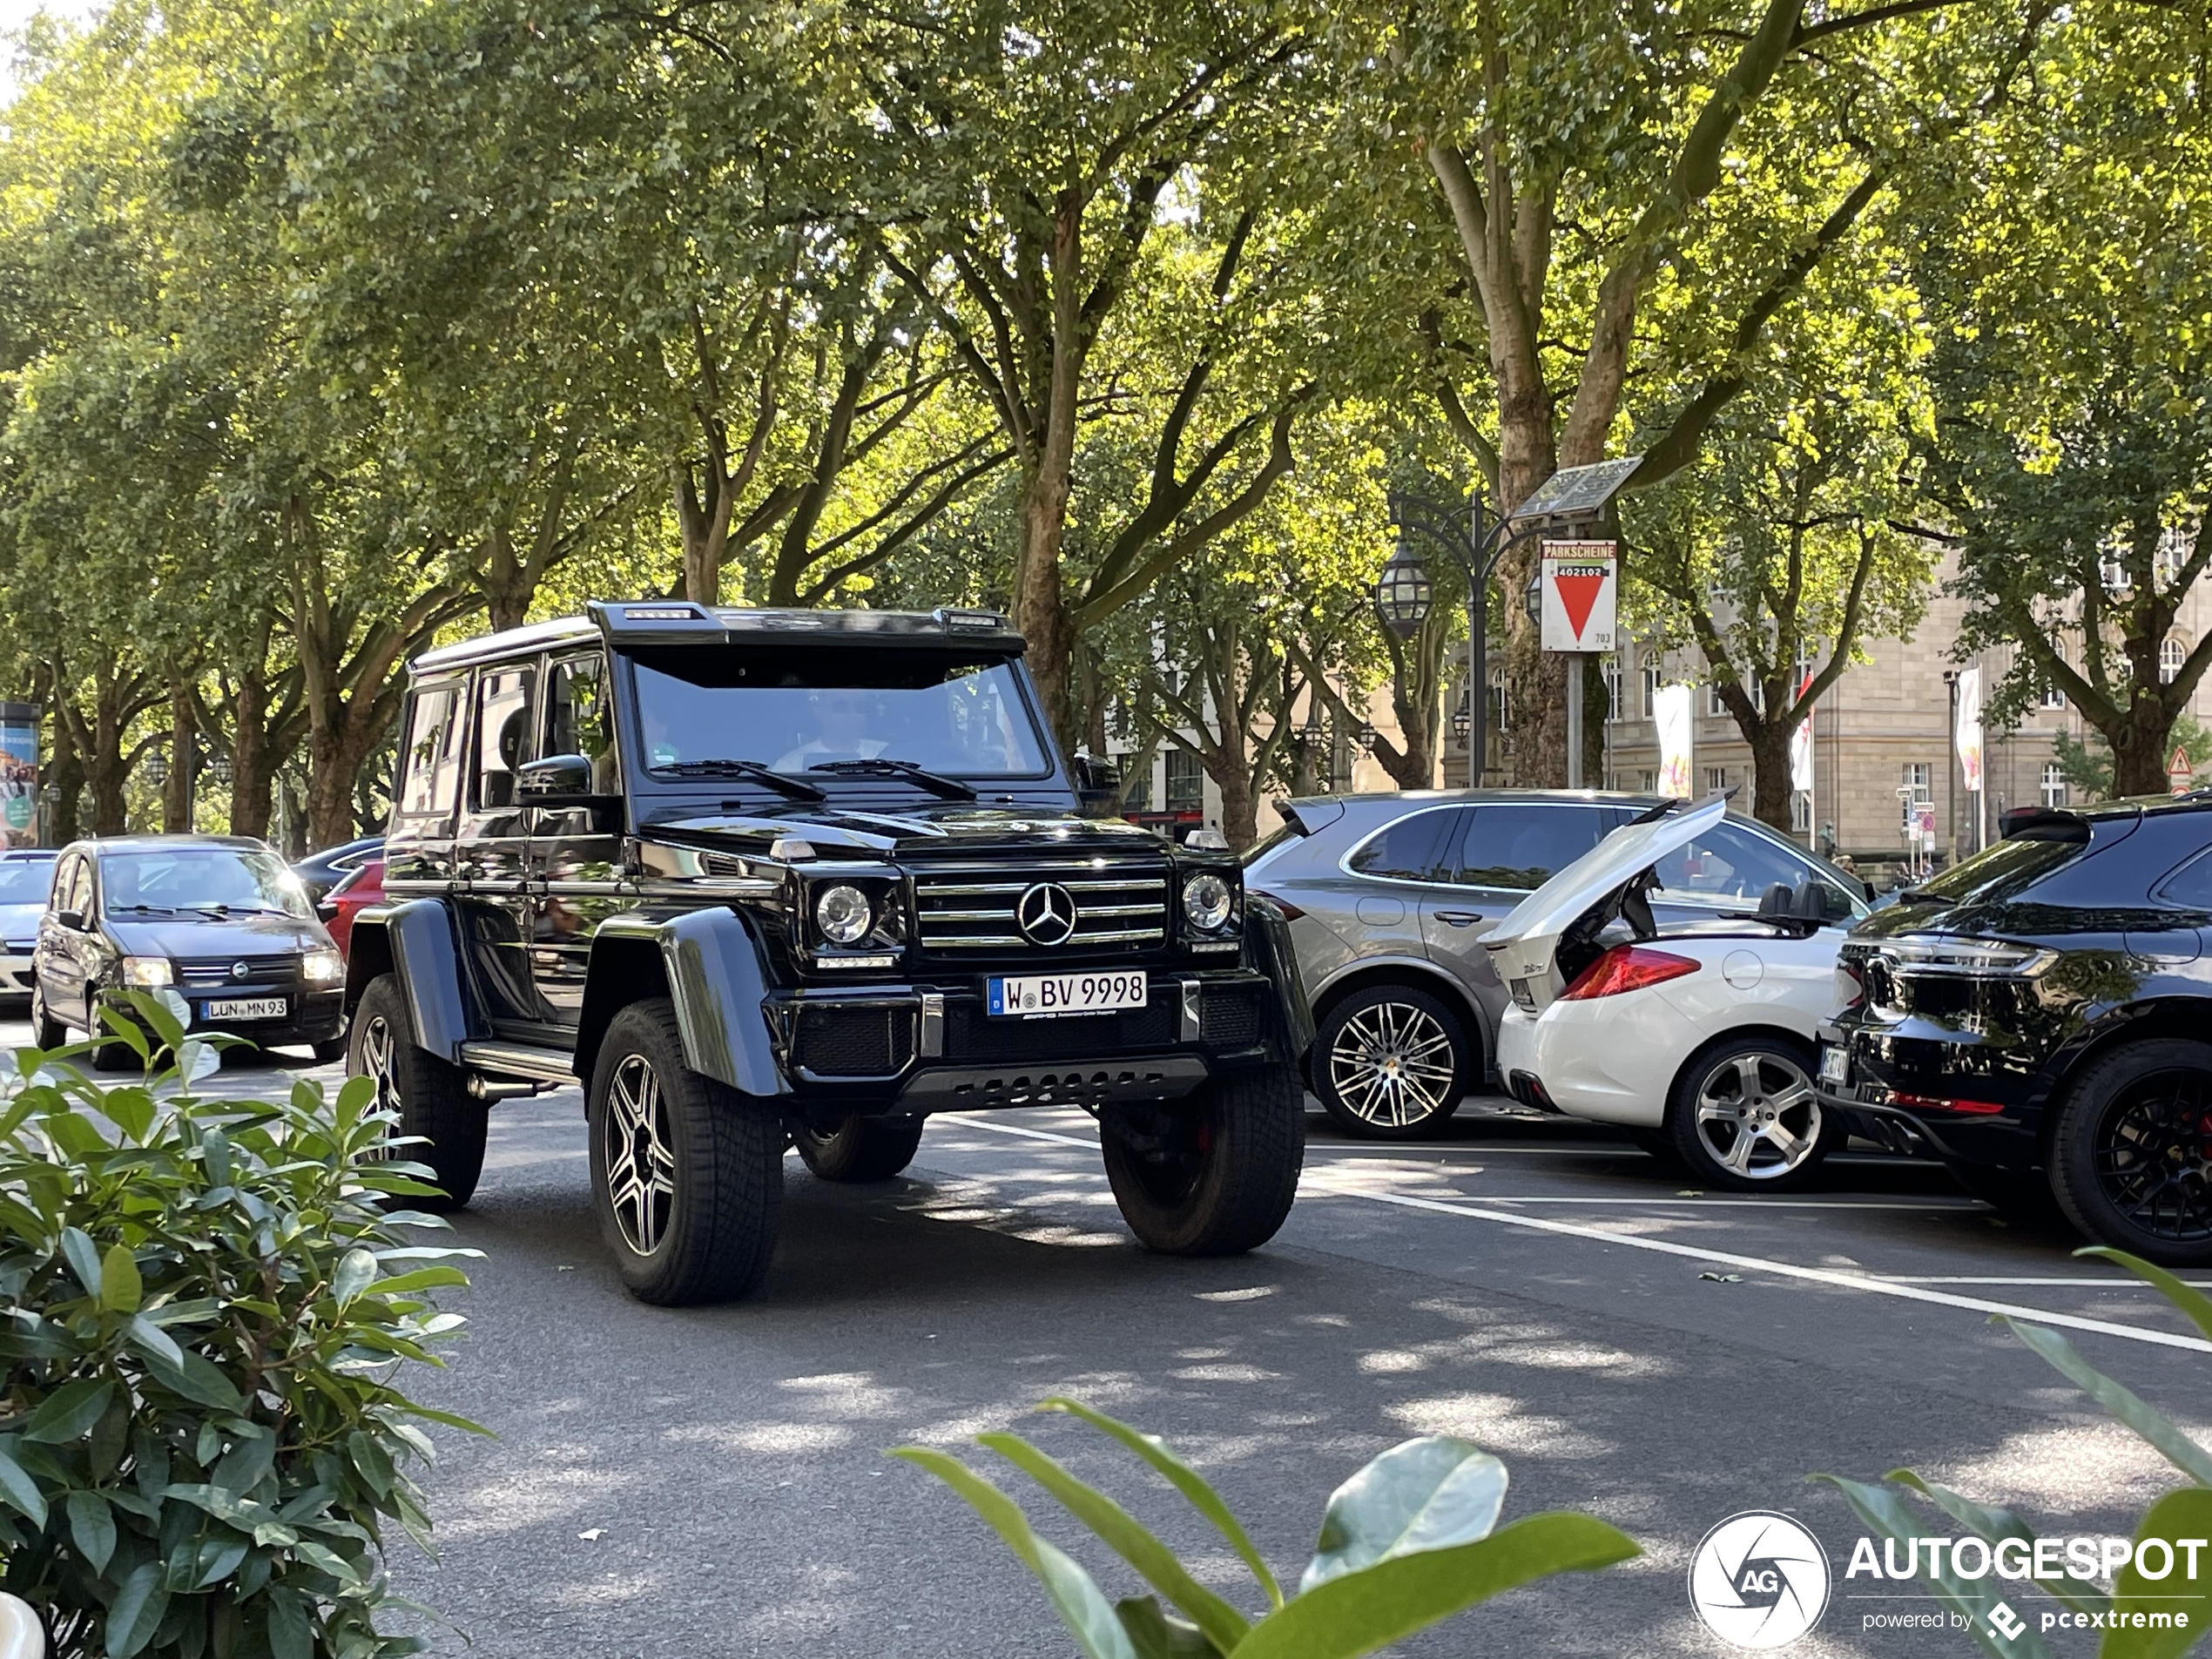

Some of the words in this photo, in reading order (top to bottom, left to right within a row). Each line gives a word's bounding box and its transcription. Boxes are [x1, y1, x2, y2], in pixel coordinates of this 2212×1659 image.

[1544, 545, 1615, 557] PARKSCHEINE
[1559, 568, 1602, 577] 402102
[1595, 633, 1610, 644] 703
[1007, 981, 1022, 1009] W
[1041, 979, 1074, 1008] BV
[1082, 975, 1143, 1005] 9998
[210, 1002, 238, 1017] LÜN
[246, 1001, 266, 1015] MN
[268, 1001, 285, 1015] 93
